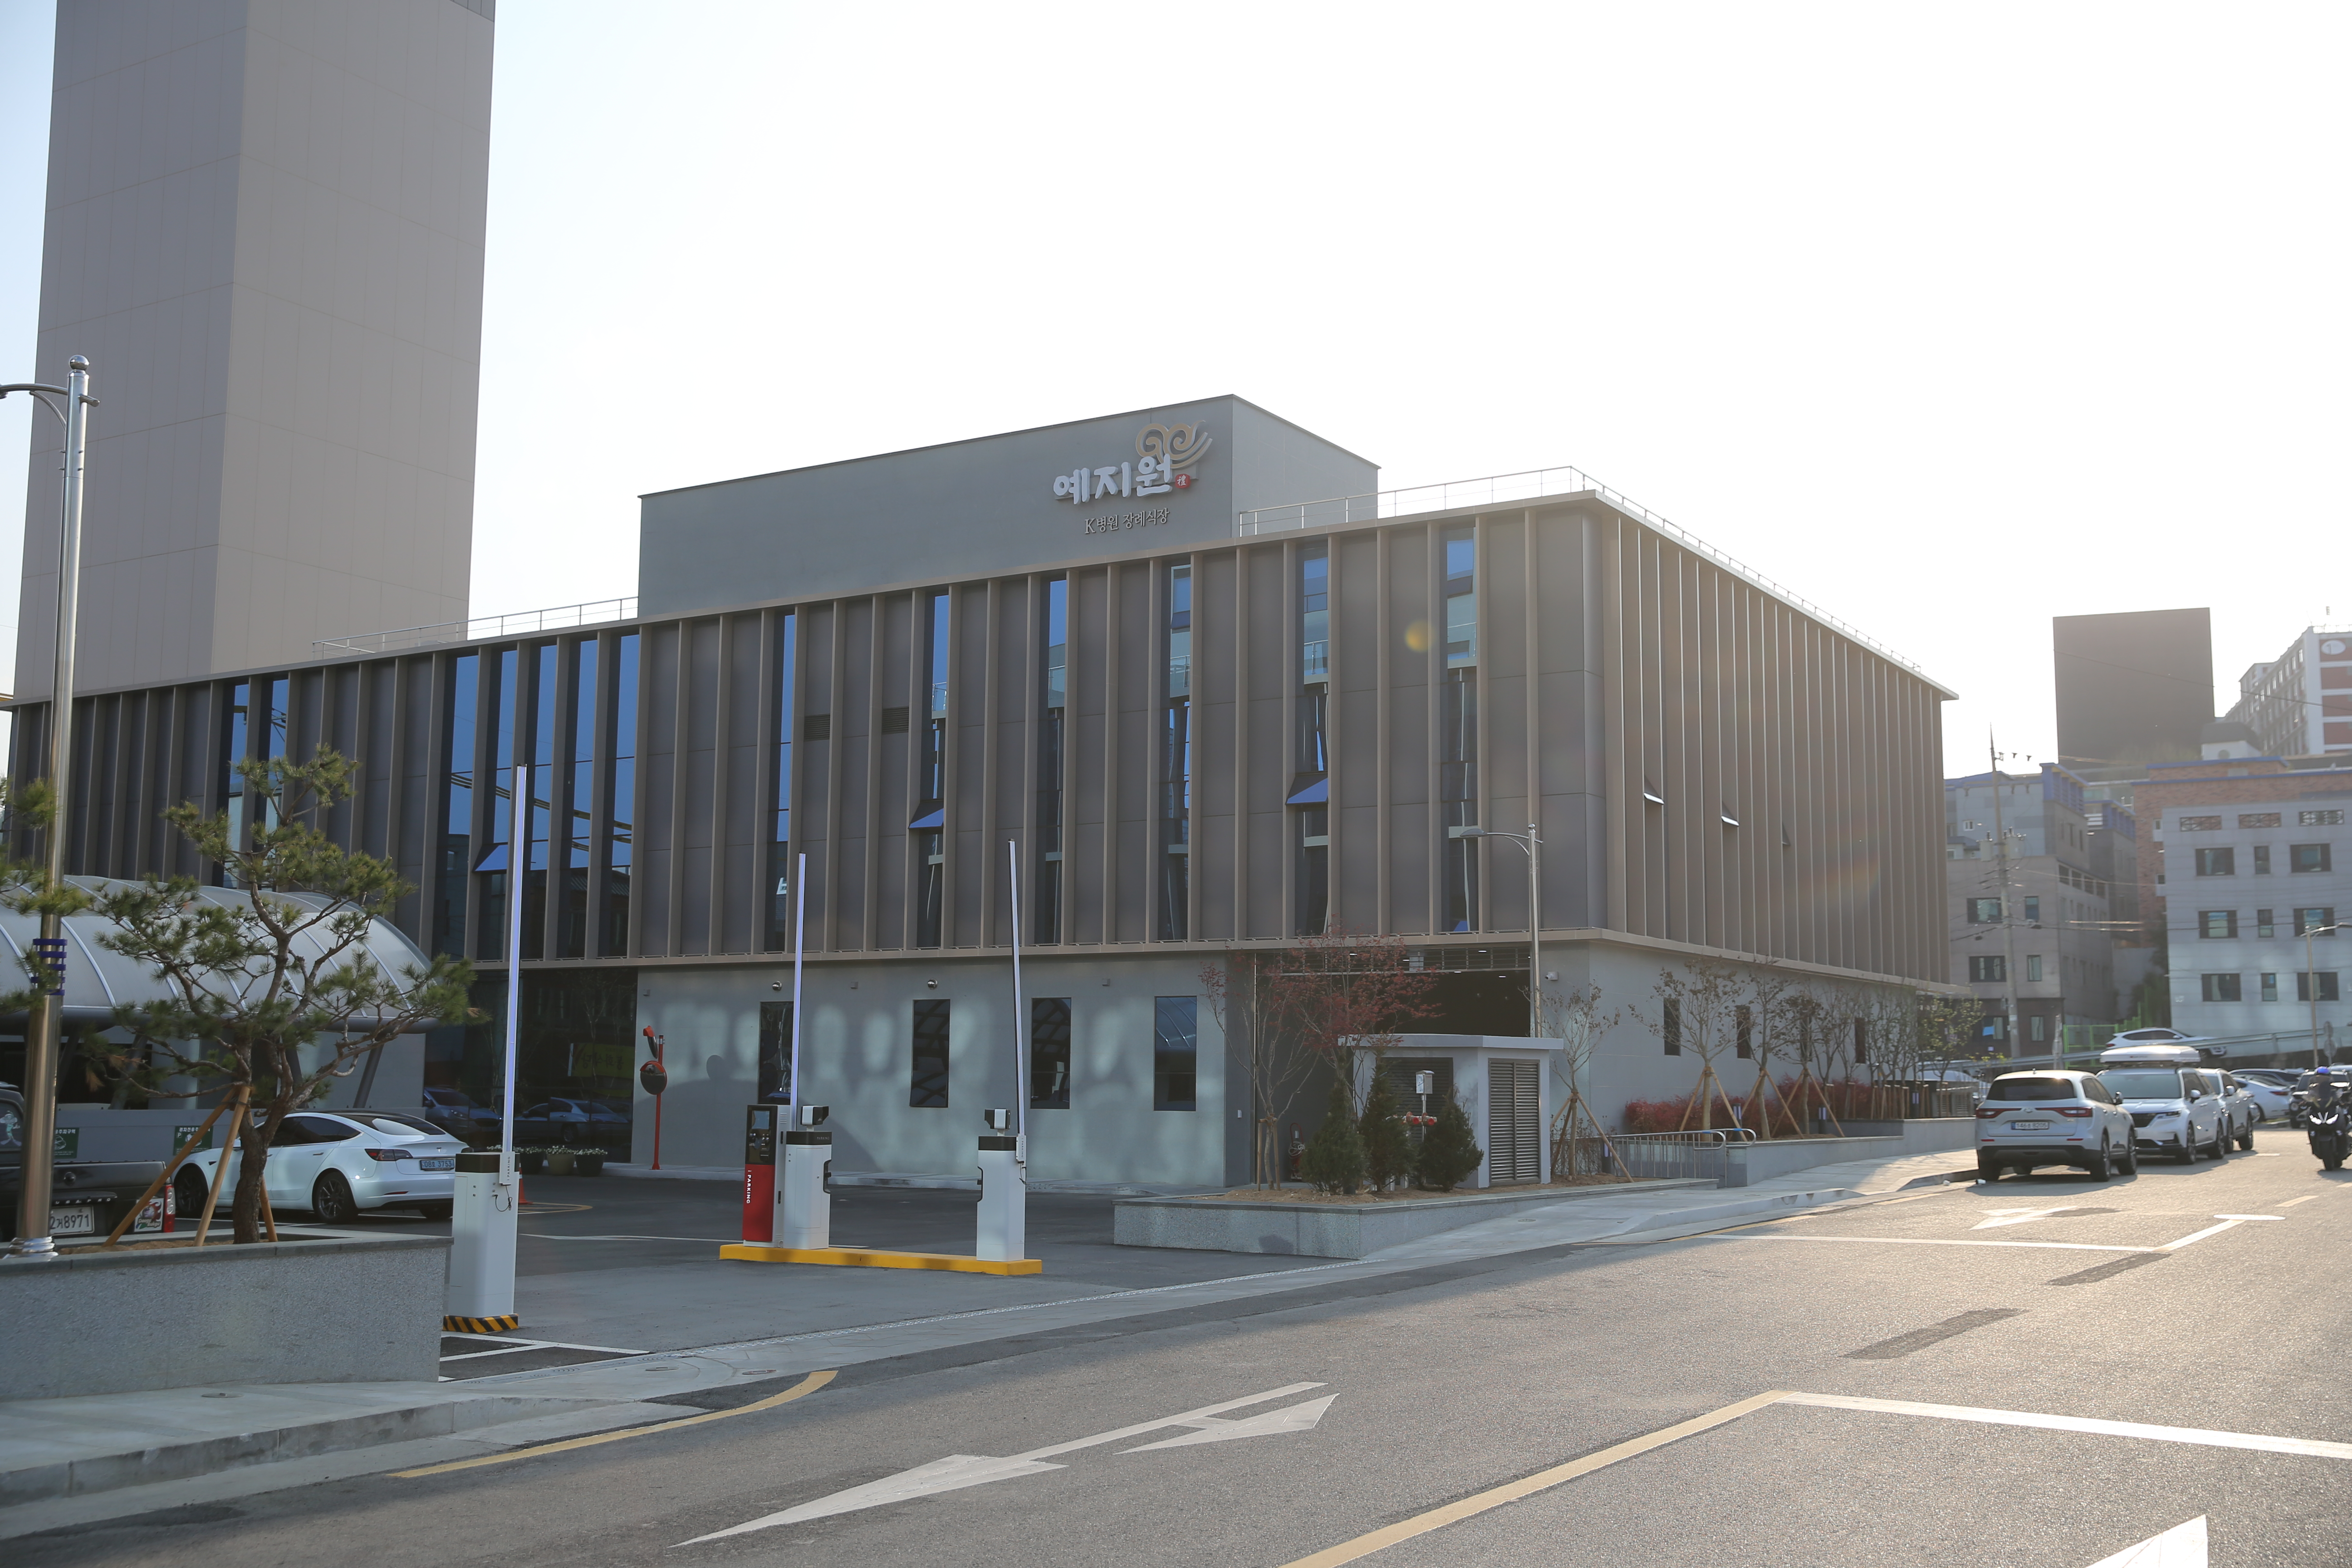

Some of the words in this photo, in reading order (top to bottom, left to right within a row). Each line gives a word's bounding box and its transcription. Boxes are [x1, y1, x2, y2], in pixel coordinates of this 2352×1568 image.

[1053, 454, 1173, 505] 예지원
[1084, 515, 1119, 534] K병원
[1122, 507, 1170, 529] 장례식장
